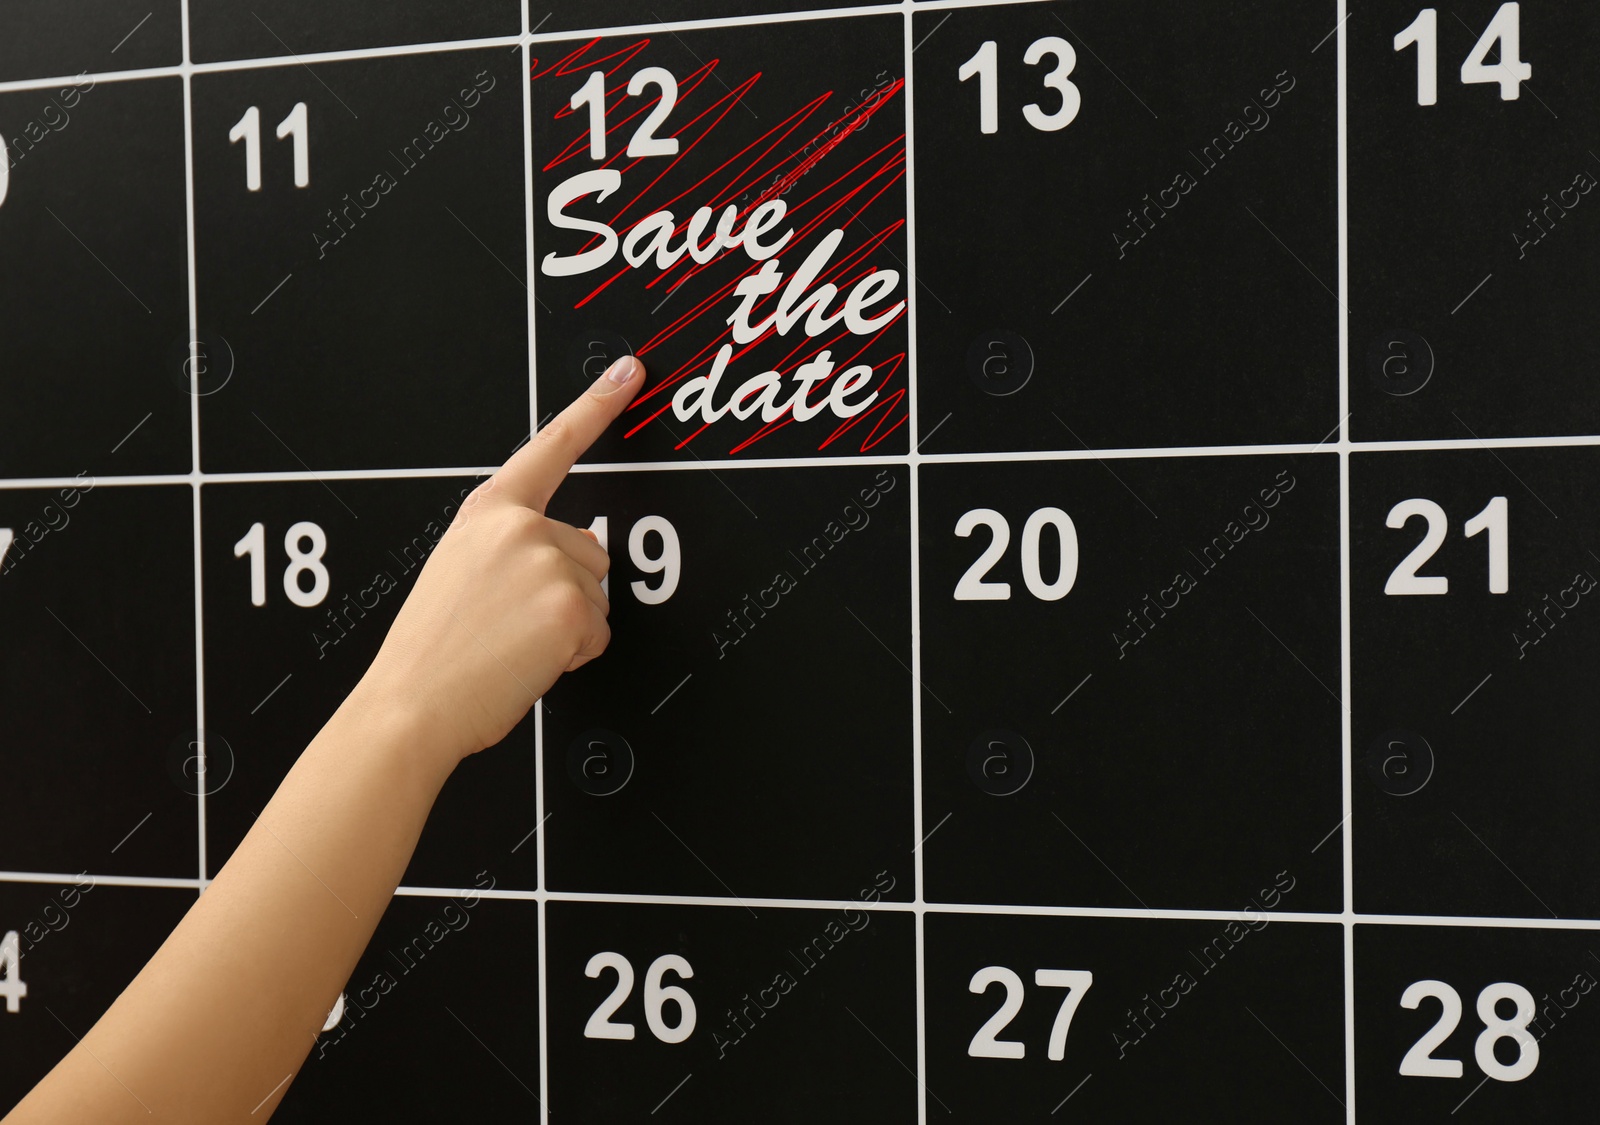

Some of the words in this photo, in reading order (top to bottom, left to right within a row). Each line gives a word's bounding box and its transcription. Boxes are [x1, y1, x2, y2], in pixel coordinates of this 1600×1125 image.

[959, 37, 1080, 134] 13
[1394, 2, 1531, 106] 14
[229, 102, 308, 191] 11
[571, 67, 679, 160] 12
[541, 169, 794, 277] Save
[726, 229, 905, 344] the
[672, 344, 878, 424] date
[234, 522, 329, 607] 18
[954, 507, 1078, 601] 20
[1384, 497, 1508, 596] 21
[584, 952, 696, 1043] 26
[968, 966, 1092, 1062] 27
[1399, 980, 1539, 1081] 28
